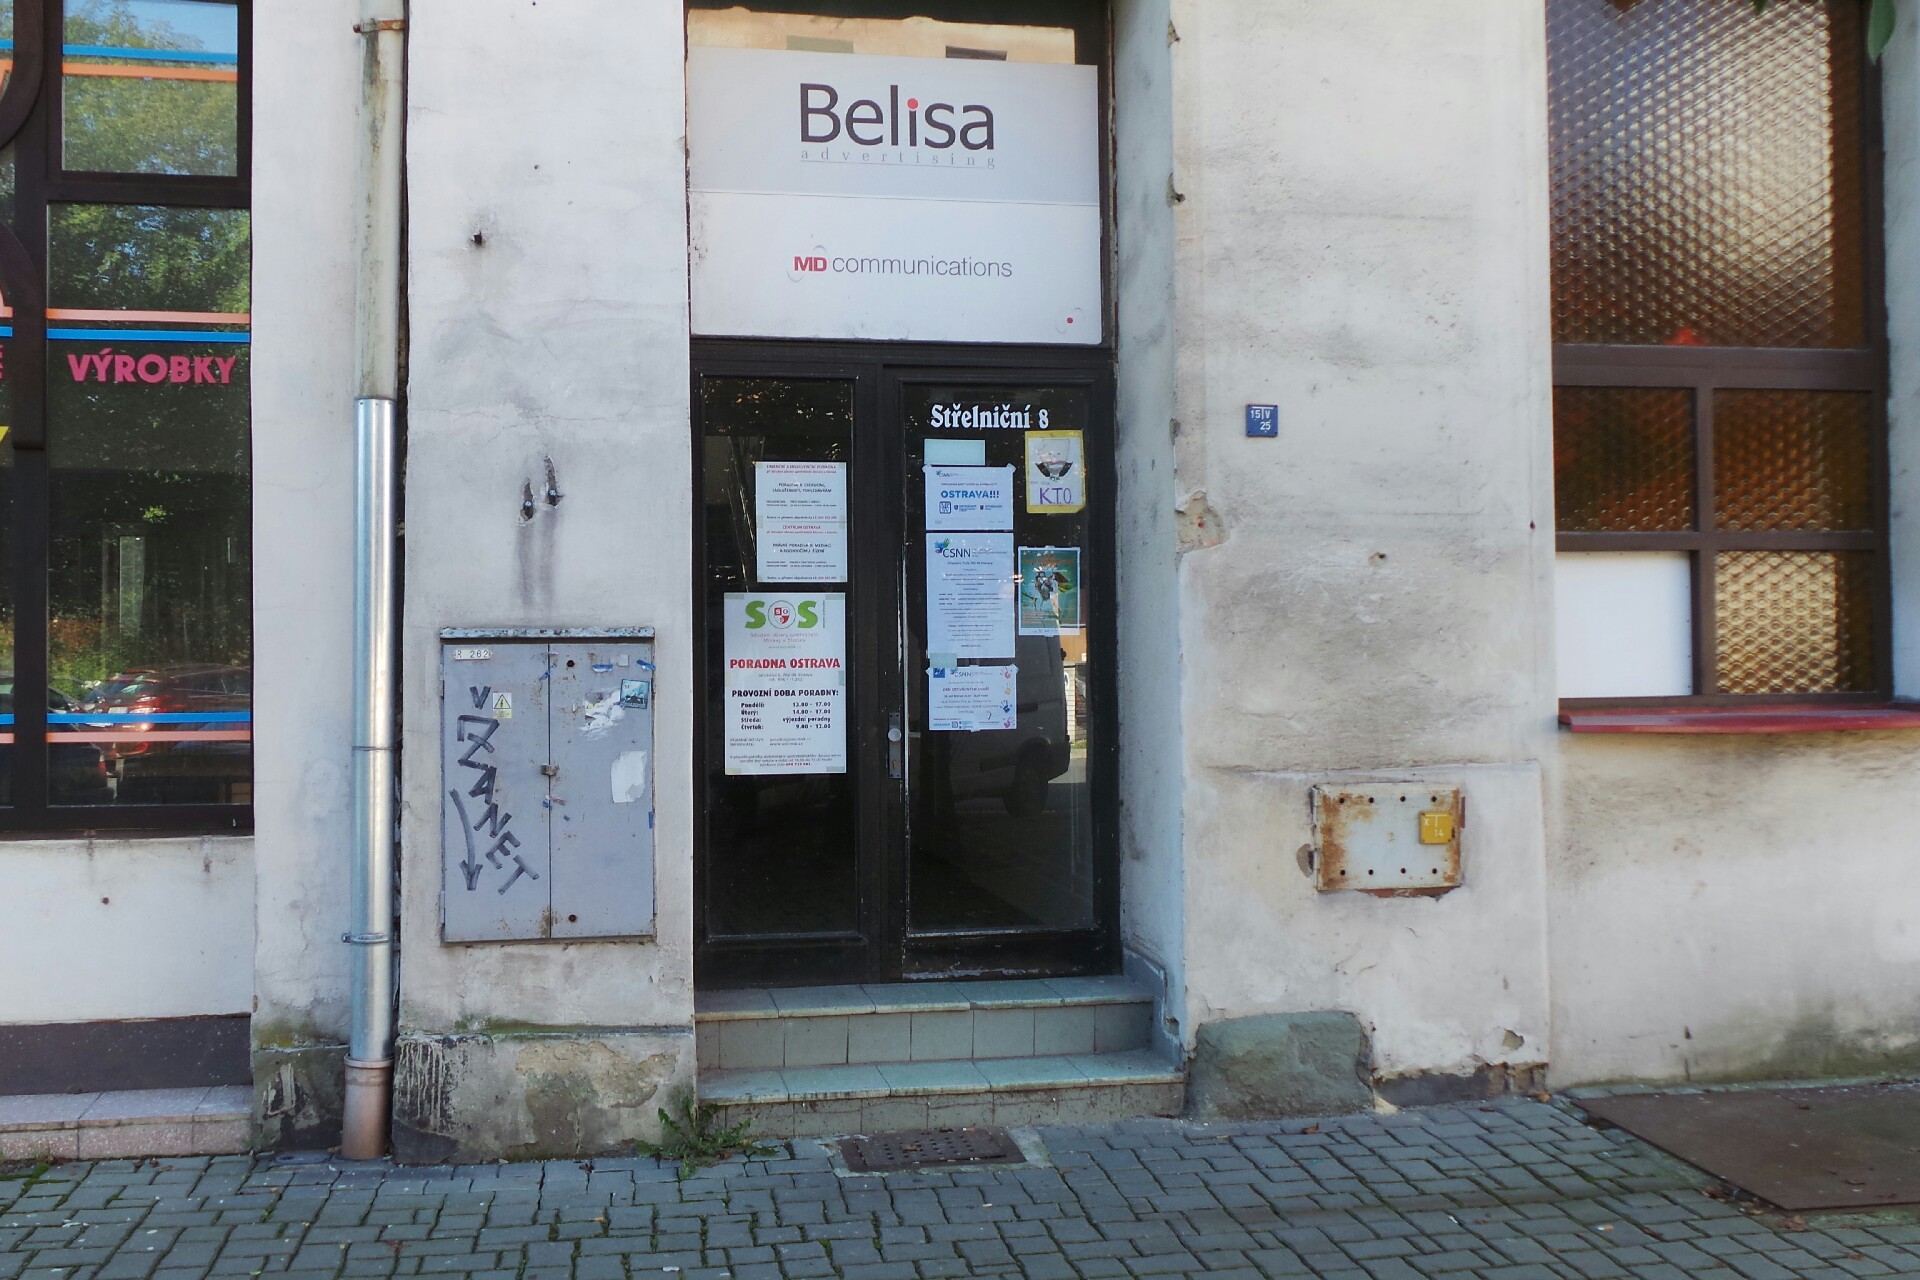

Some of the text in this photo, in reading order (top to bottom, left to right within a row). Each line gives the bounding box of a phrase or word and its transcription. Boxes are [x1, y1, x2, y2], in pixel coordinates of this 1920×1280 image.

[800, 83, 995, 150] Belisa
[800, 148, 995, 169] advertising
[794, 254, 1013, 278] MD communications
[67, 348, 237, 384] VÝROBKY
[930, 403, 1050, 429] Střelniční 8
[1260, 421, 1271, 431] 25
[940, 490, 1000, 499] OSTRAVA!!!
[942, 548, 971, 558] CSNN
[470, 649, 489, 659] 262
[730, 658, 841, 669] PORADNA OSTRAVA
[731, 688, 839, 698] PROVOZNÍ DOBA PORADNY:
